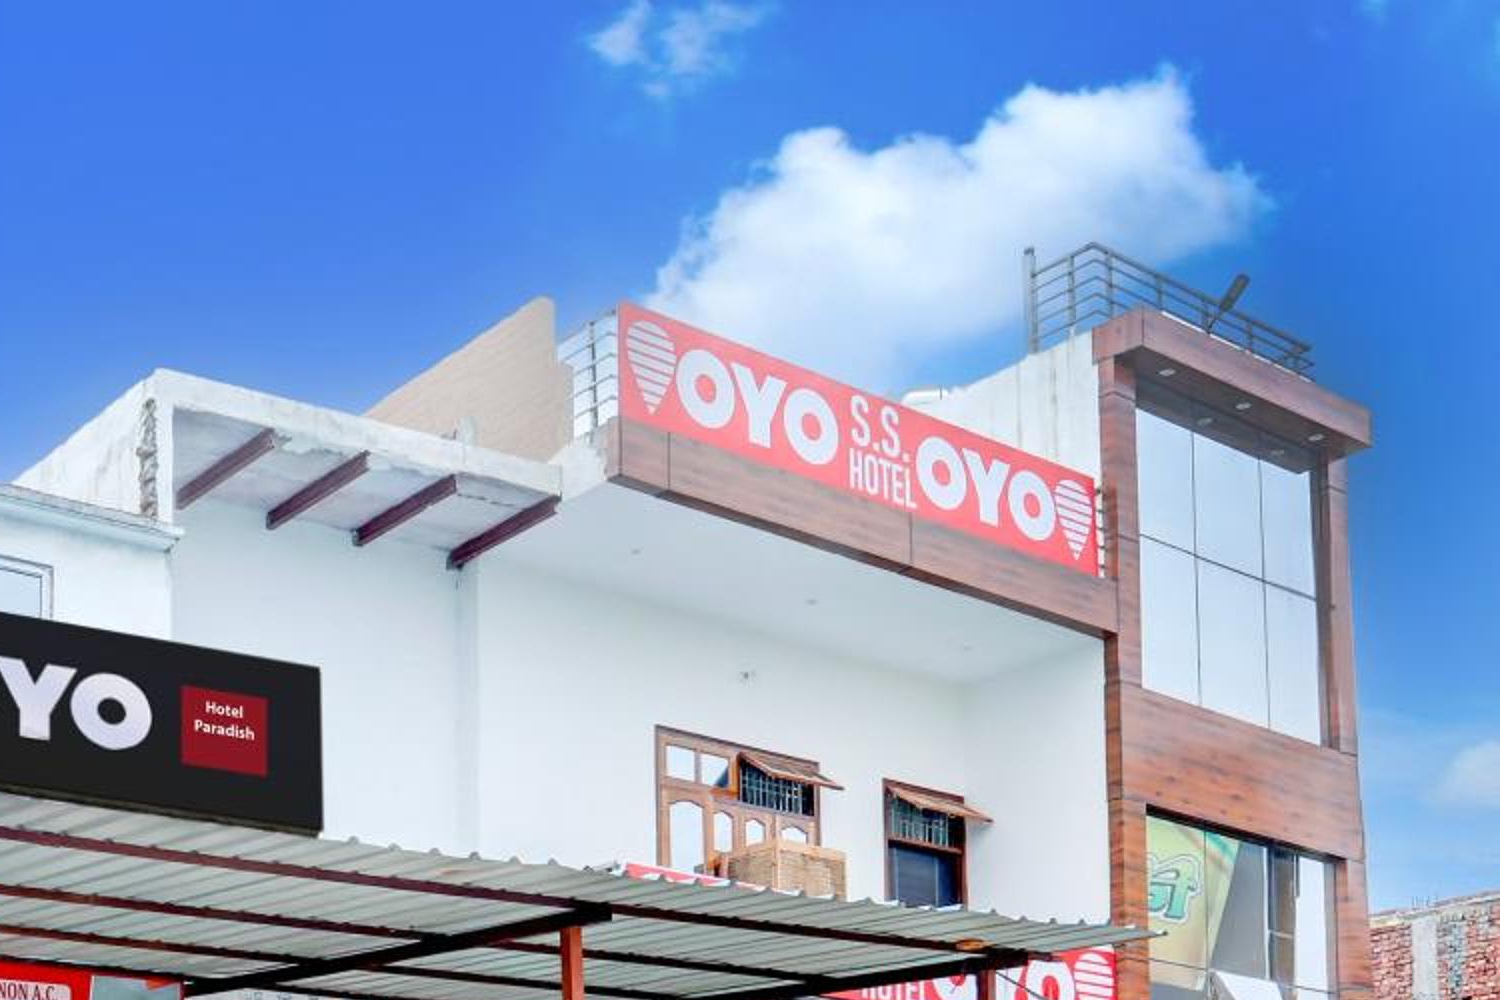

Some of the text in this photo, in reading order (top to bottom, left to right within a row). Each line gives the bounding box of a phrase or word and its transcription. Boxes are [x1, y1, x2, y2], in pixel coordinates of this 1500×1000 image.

[675, 349, 839, 465] OYO
[850, 395, 911, 461] S.S.
[849, 447, 916, 509] HOTEL
[916, 436, 1056, 541] OYO
[193, 718, 256, 741] Paradish
[204, 700, 244, 719] Hotel
